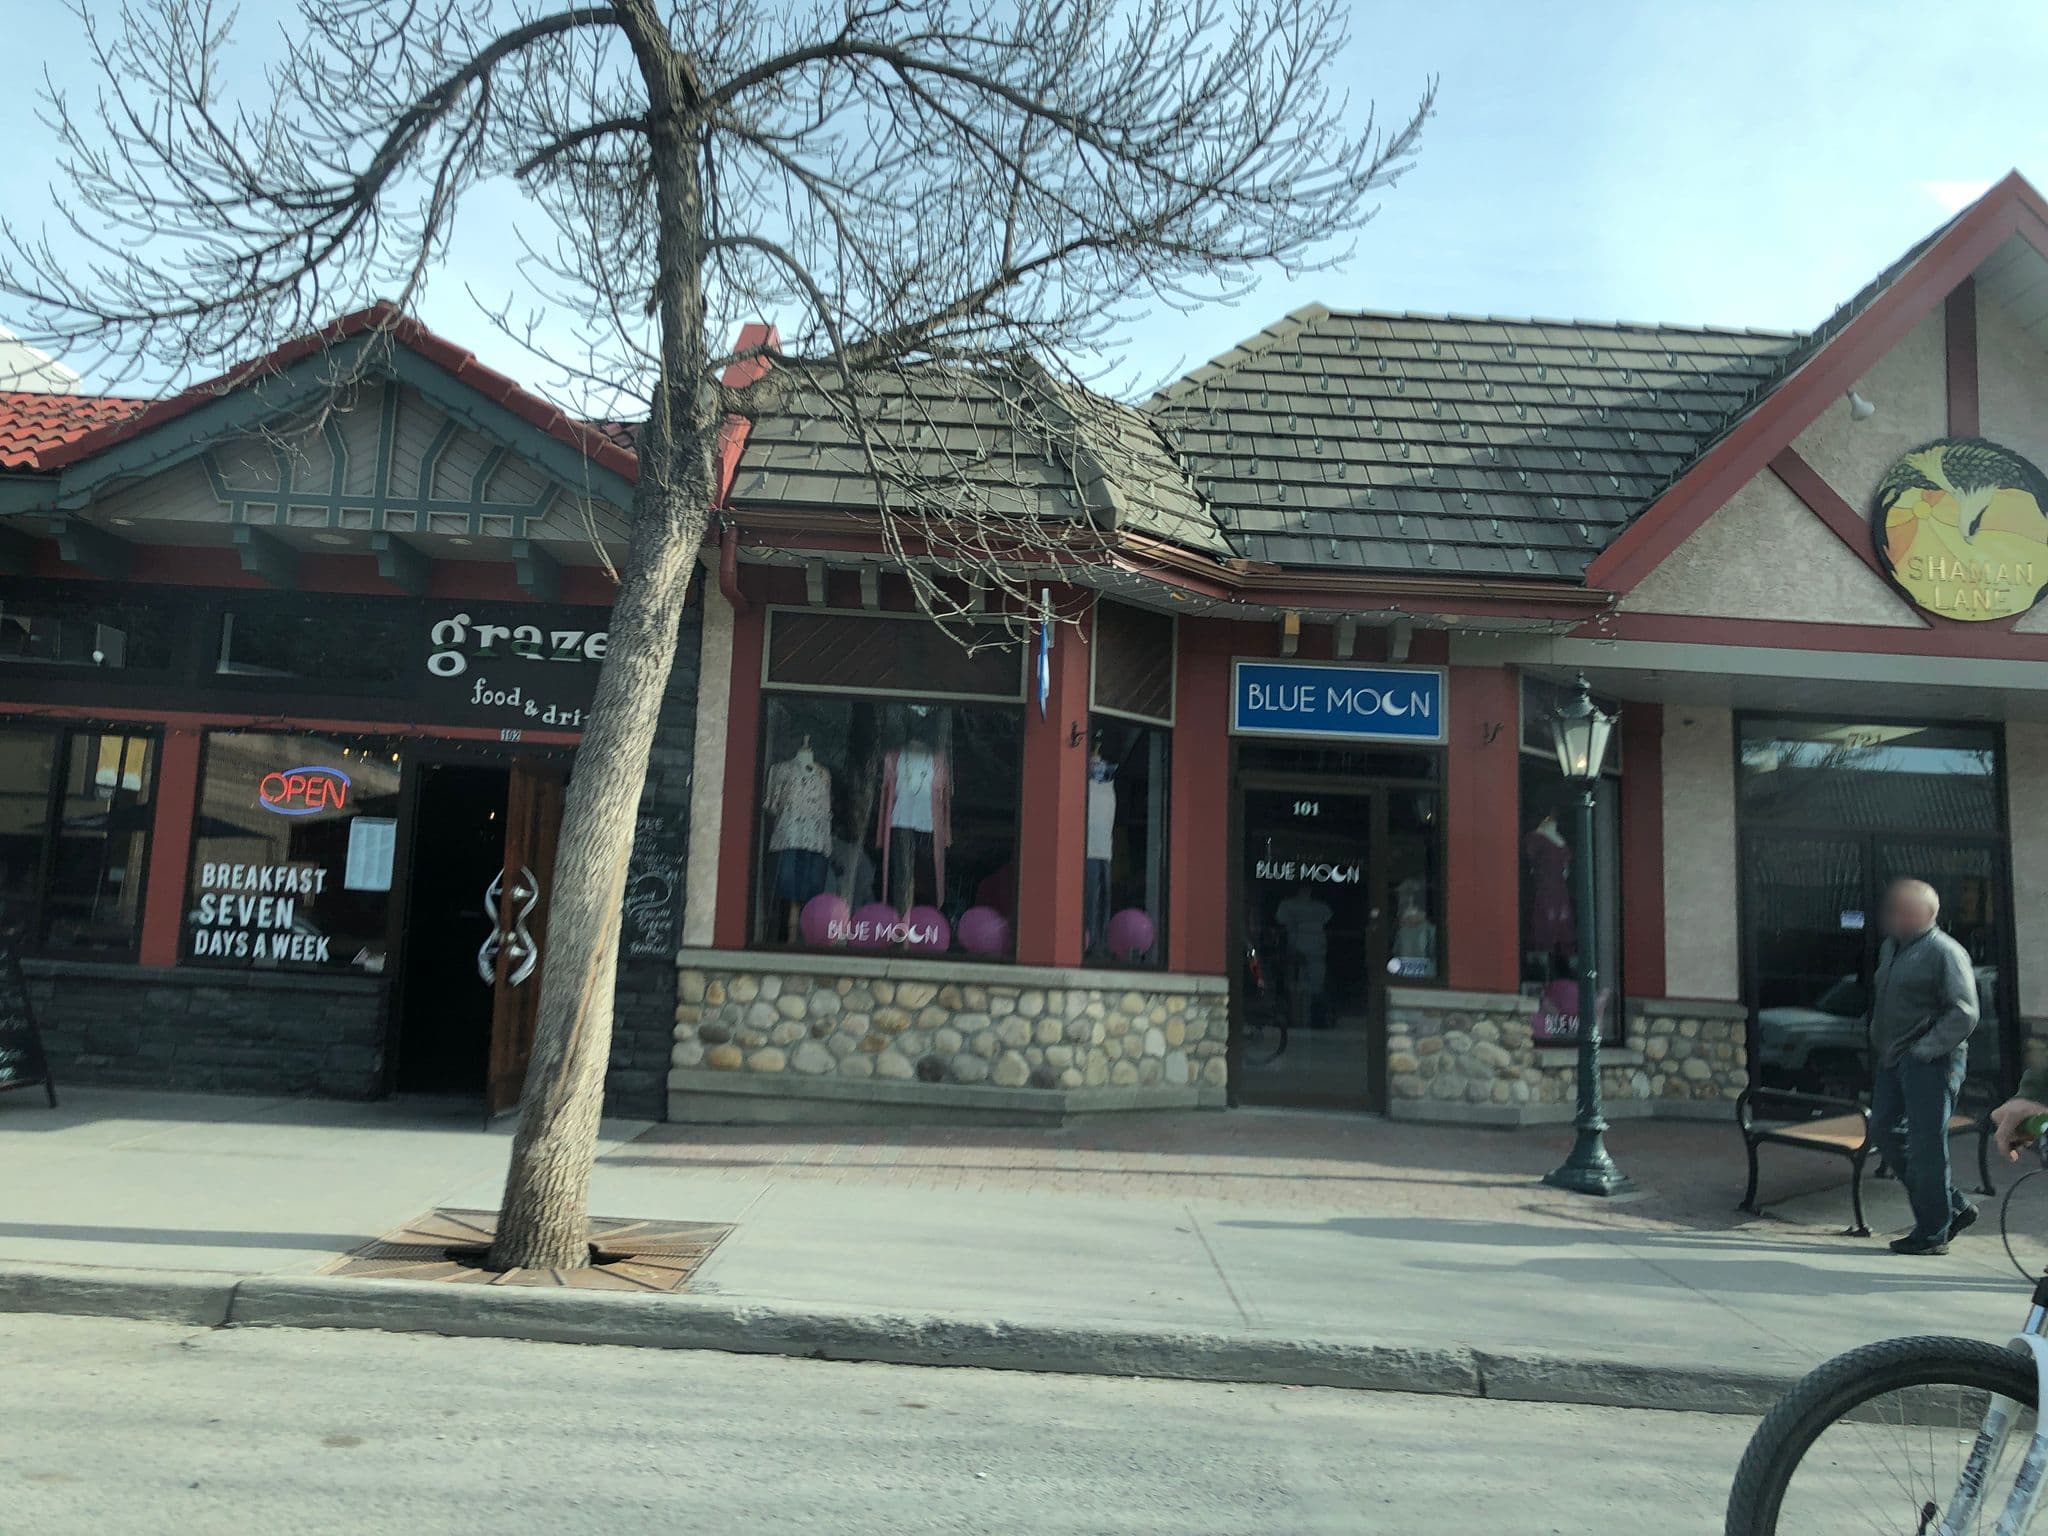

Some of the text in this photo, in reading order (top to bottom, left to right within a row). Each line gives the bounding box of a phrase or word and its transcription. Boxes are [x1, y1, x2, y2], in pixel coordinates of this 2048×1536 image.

[1907, 556, 2033, 586] SHAMAN
[1935, 585, 2012, 613] LANE
[427, 613, 608, 677] graze
[470, 677, 590, 726] food & dri
[1248, 682, 1431, 718] BLUE MOON
[259, 772, 347, 809] OPEN
[1291, 801, 1320, 816] 101
[202, 863, 328, 895] BREAKFAST
[1255, 860, 1361, 884] BLUE MOON
[199, 892, 295, 929] SEVEN
[194, 929, 331, 962] DAYS A WEEK
[827, 919, 939, 944] BLUE MOON
